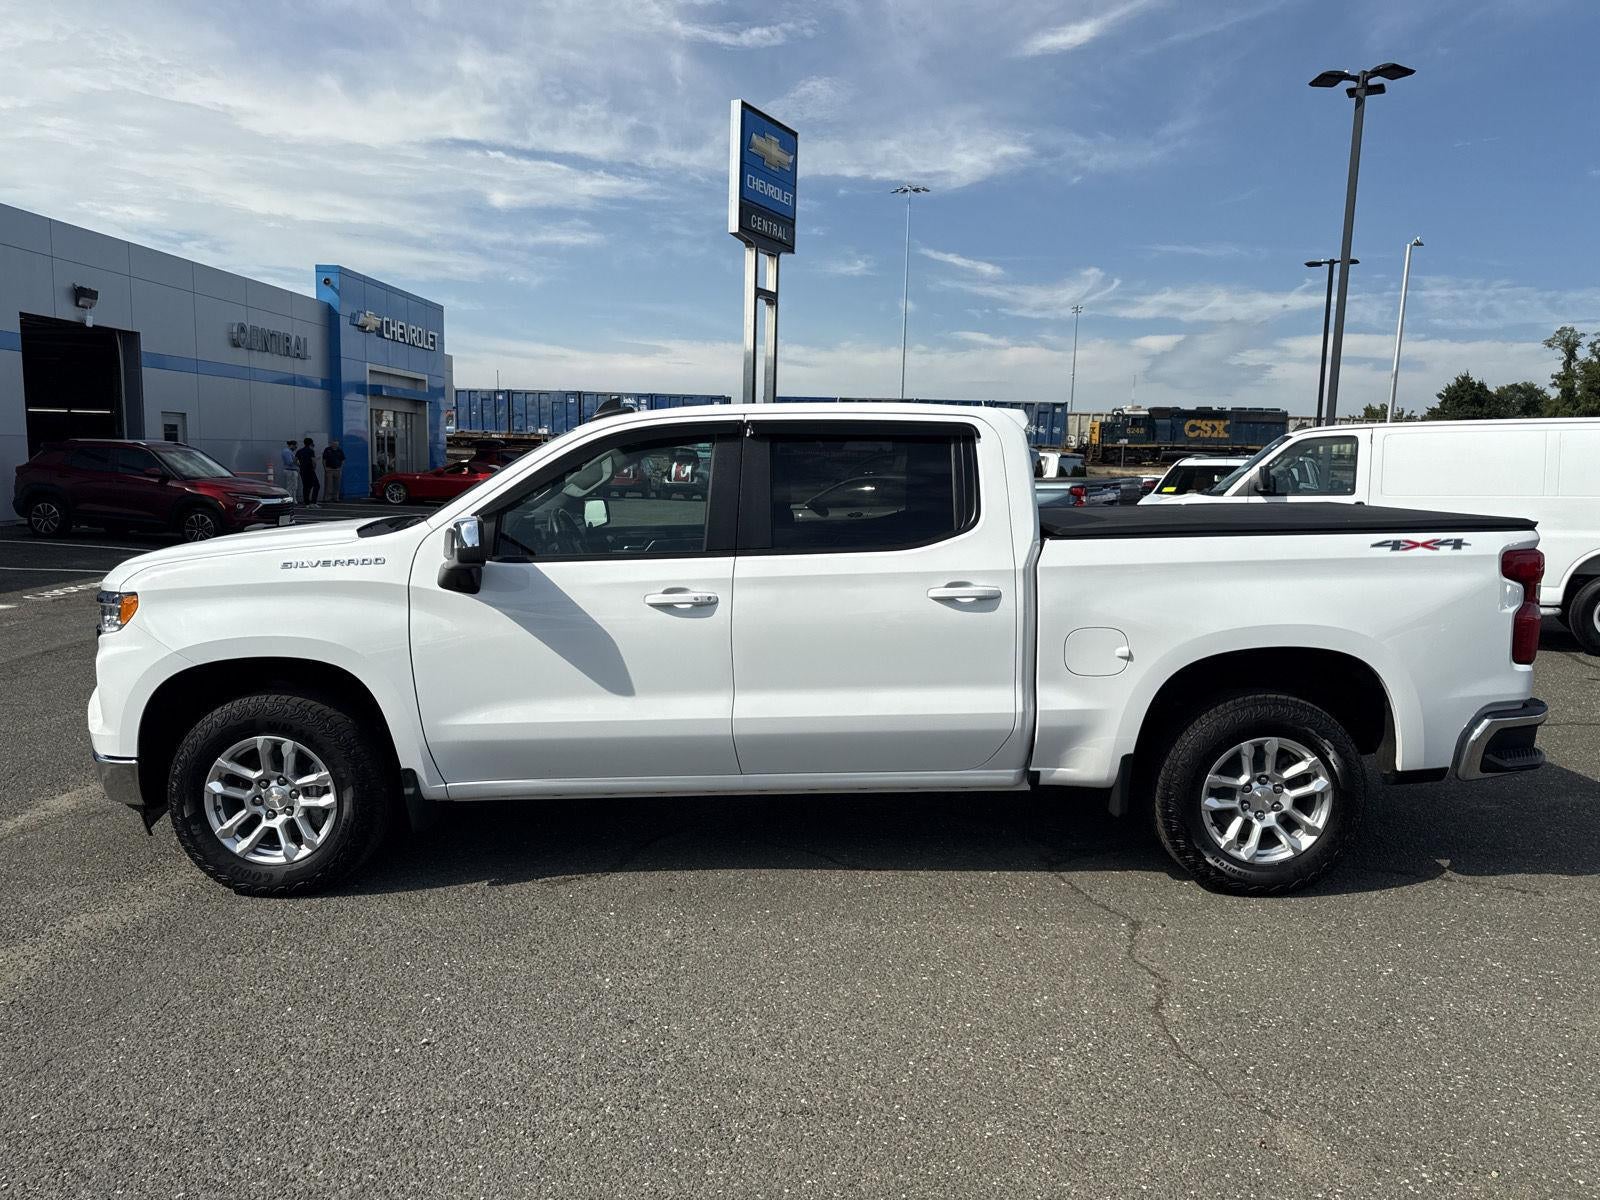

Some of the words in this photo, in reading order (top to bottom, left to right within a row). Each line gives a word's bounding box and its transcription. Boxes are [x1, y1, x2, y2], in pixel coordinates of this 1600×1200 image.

[747, 174, 793, 206] CHEVROLET
[751, 214, 787, 240] CENTRAL
[230, 321, 311, 361] CENTRAL
[383, 315, 439, 351] CHEVROLET
[1184, 419, 1230, 438] CSX
[280, 557, 386, 569] SILVERADO
